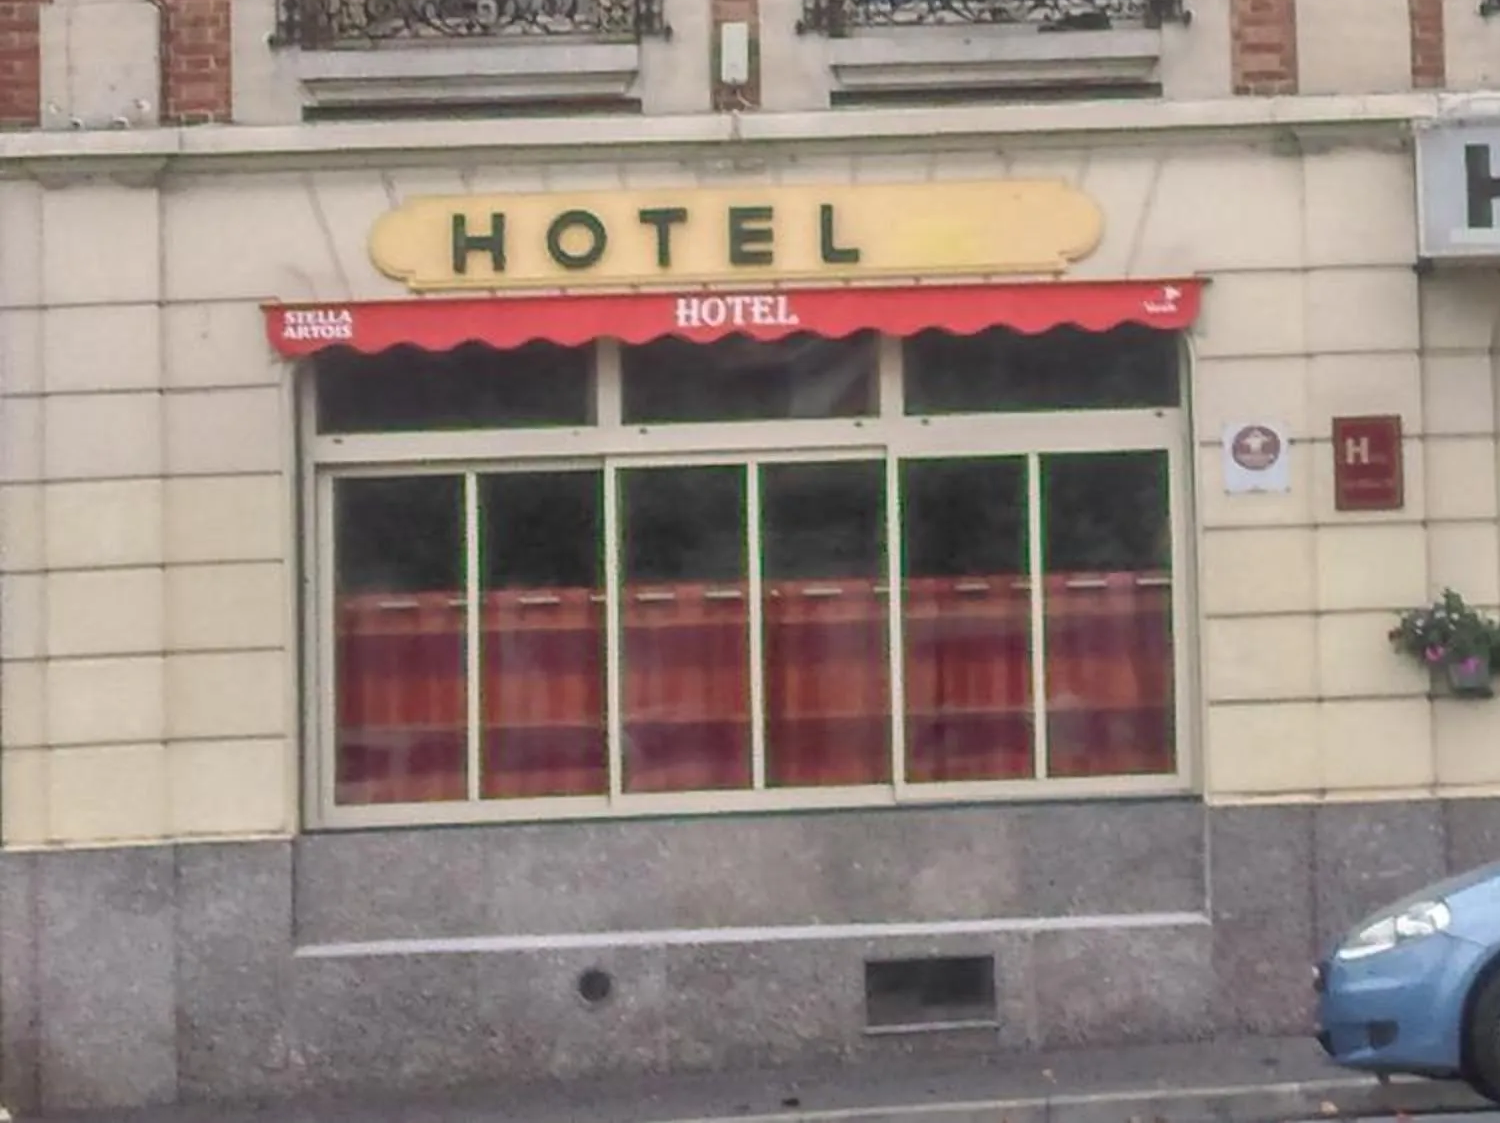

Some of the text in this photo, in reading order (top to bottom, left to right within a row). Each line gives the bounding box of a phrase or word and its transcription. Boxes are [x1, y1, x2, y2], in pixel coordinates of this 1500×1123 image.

[452, 204, 860, 274] HOTEL
[283, 309, 352, 324] STELLA
[676, 295, 799, 327] HOTEL
[283, 324, 353, 340] ARTOIS
